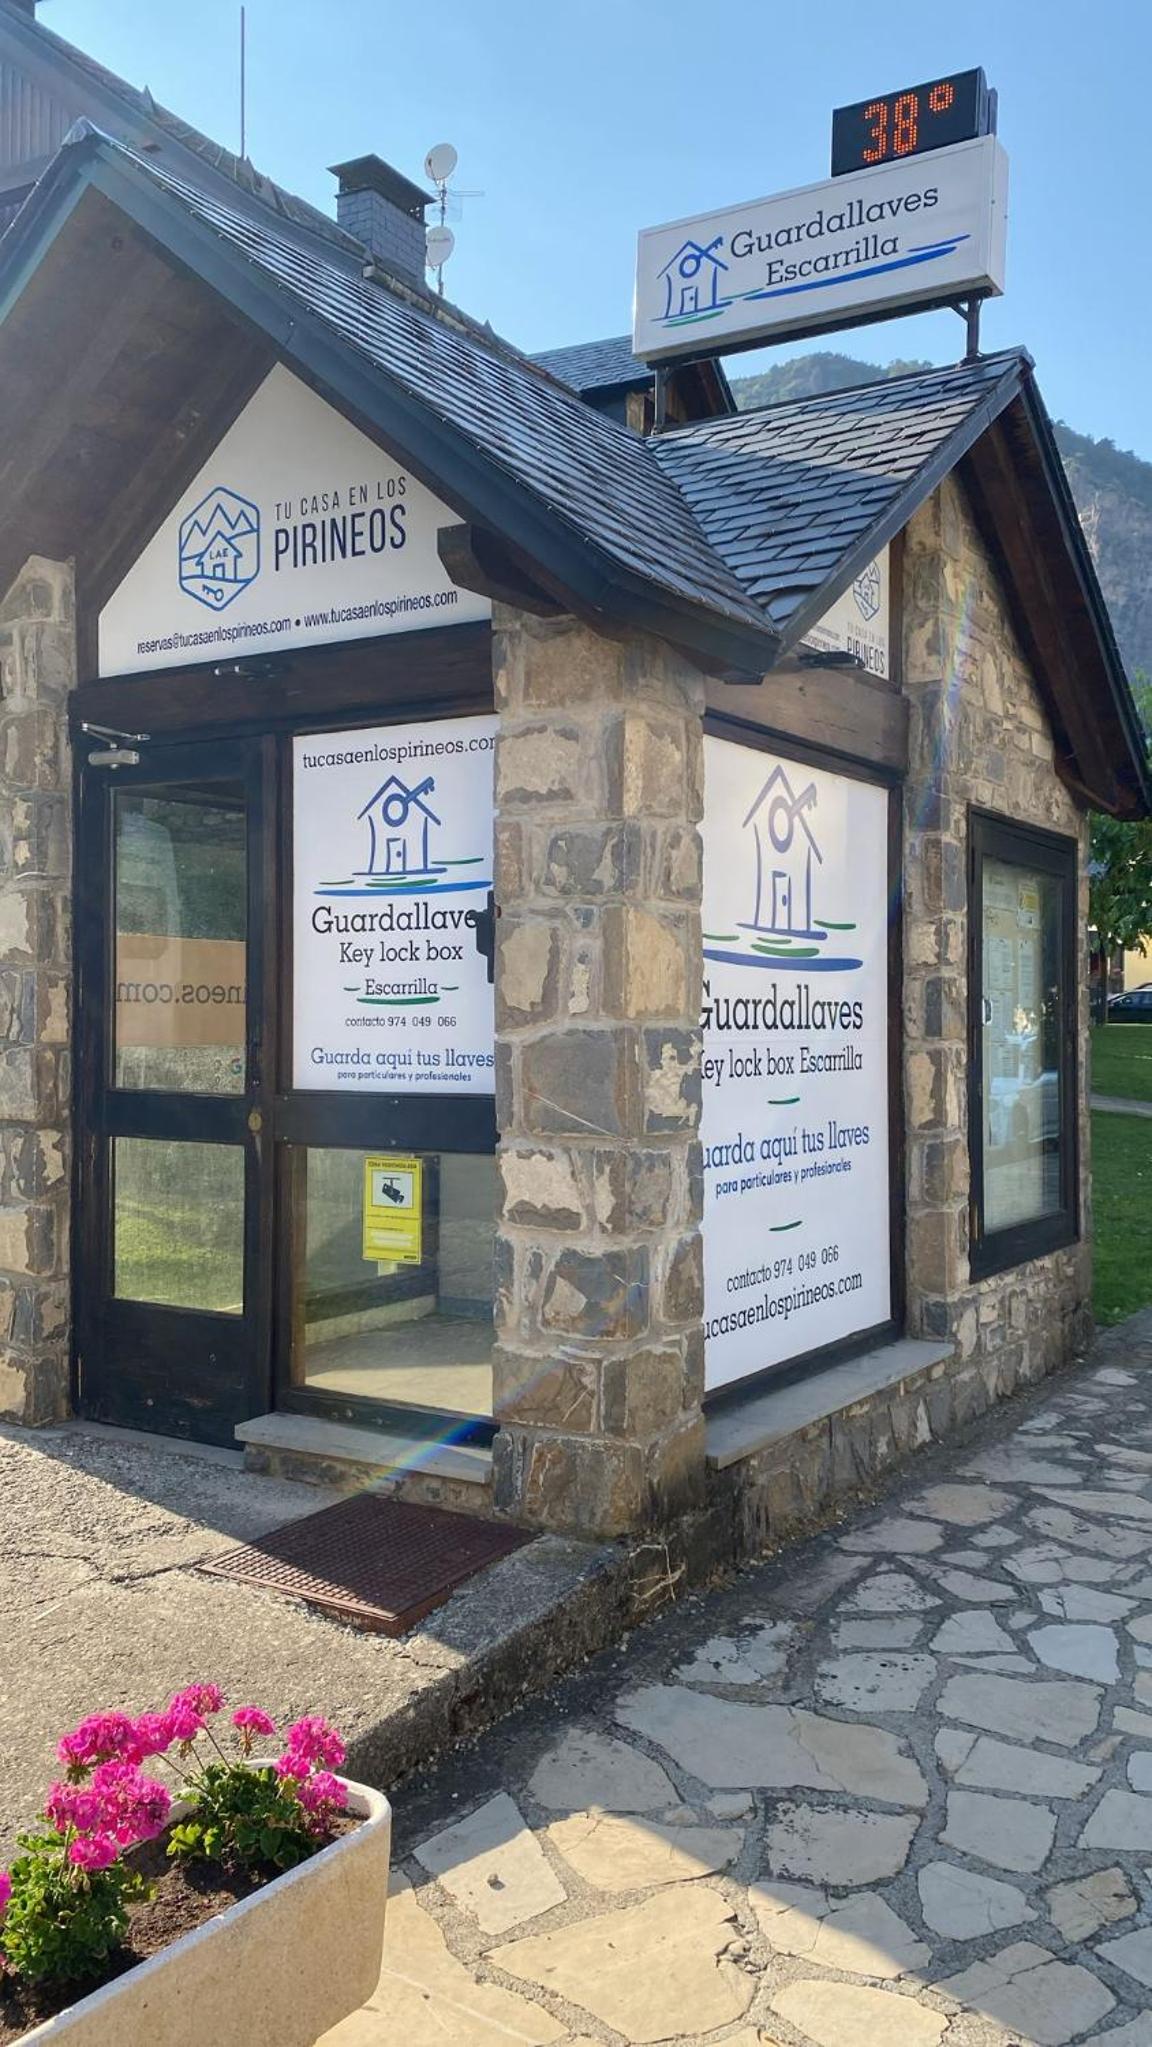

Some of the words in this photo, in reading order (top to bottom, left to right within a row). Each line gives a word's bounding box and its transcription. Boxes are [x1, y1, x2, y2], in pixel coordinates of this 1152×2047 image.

[730, 187, 938, 258] Guardallaves
[765, 235, 899, 286] Escarrilla
[275, 502, 292, 521] TU
[300, 490, 340, 515] CASA
[349, 484, 368, 506] EN
[377, 476, 407, 499] LOS
[209, 547, 230, 560] LAE
[275, 505, 407, 572] PIRINEOS
[137, 615, 291, 653] reservas@tucasaenlospirineos.com
[304, 591, 458, 629] www.tucasaenlospirineos.com
[312, 902, 477, 934] Guardallave
[339, 942, 374, 968] Key
[380, 940, 420, 963] lock
[426, 939, 464, 961] box
[365, 978, 438, 996] Escarrilla
[345, 1016, 386, 1027] contacto
[387, 1016, 406, 1027] 974
[412, 1016, 431, 1027] 049
[437, 1016, 457, 1027] 066
[311, 1047, 371, 1064] Guarda
[417, 1051, 440, 1066] tus
[445, 1048, 495, 1067] llaves
[338, 1071, 356, 1079] para
[358, 1070, 405, 1080] particulares
[415, 1072, 471, 1081] profesionales
[701, 1050, 724, 1087] ey
[728, 1048, 762, 1078] lock
[767, 1048, 794, 1076] box
[799, 1045, 863, 1074] Escarrilla
[703, 1132, 755, 1169] uarda
[760, 1127, 798, 1165] aquí
[802, 1127, 824, 1154] tus
[828, 1120, 870, 1149] llaves
[716, 1180, 738, 1198] para
[740, 1170, 793, 1194] particulares
[794, 1171, 800, 1185] y
[801, 1158, 852, 1180] profesionales
[727, 1267, 773, 1293] contacto
[774, 1257, 793, 1280] 974
[798, 1252, 817, 1273] 049
[821, 1244, 840, 1265] 066
[704, 1272, 863, 1340] ucasaenlospirineos.com
